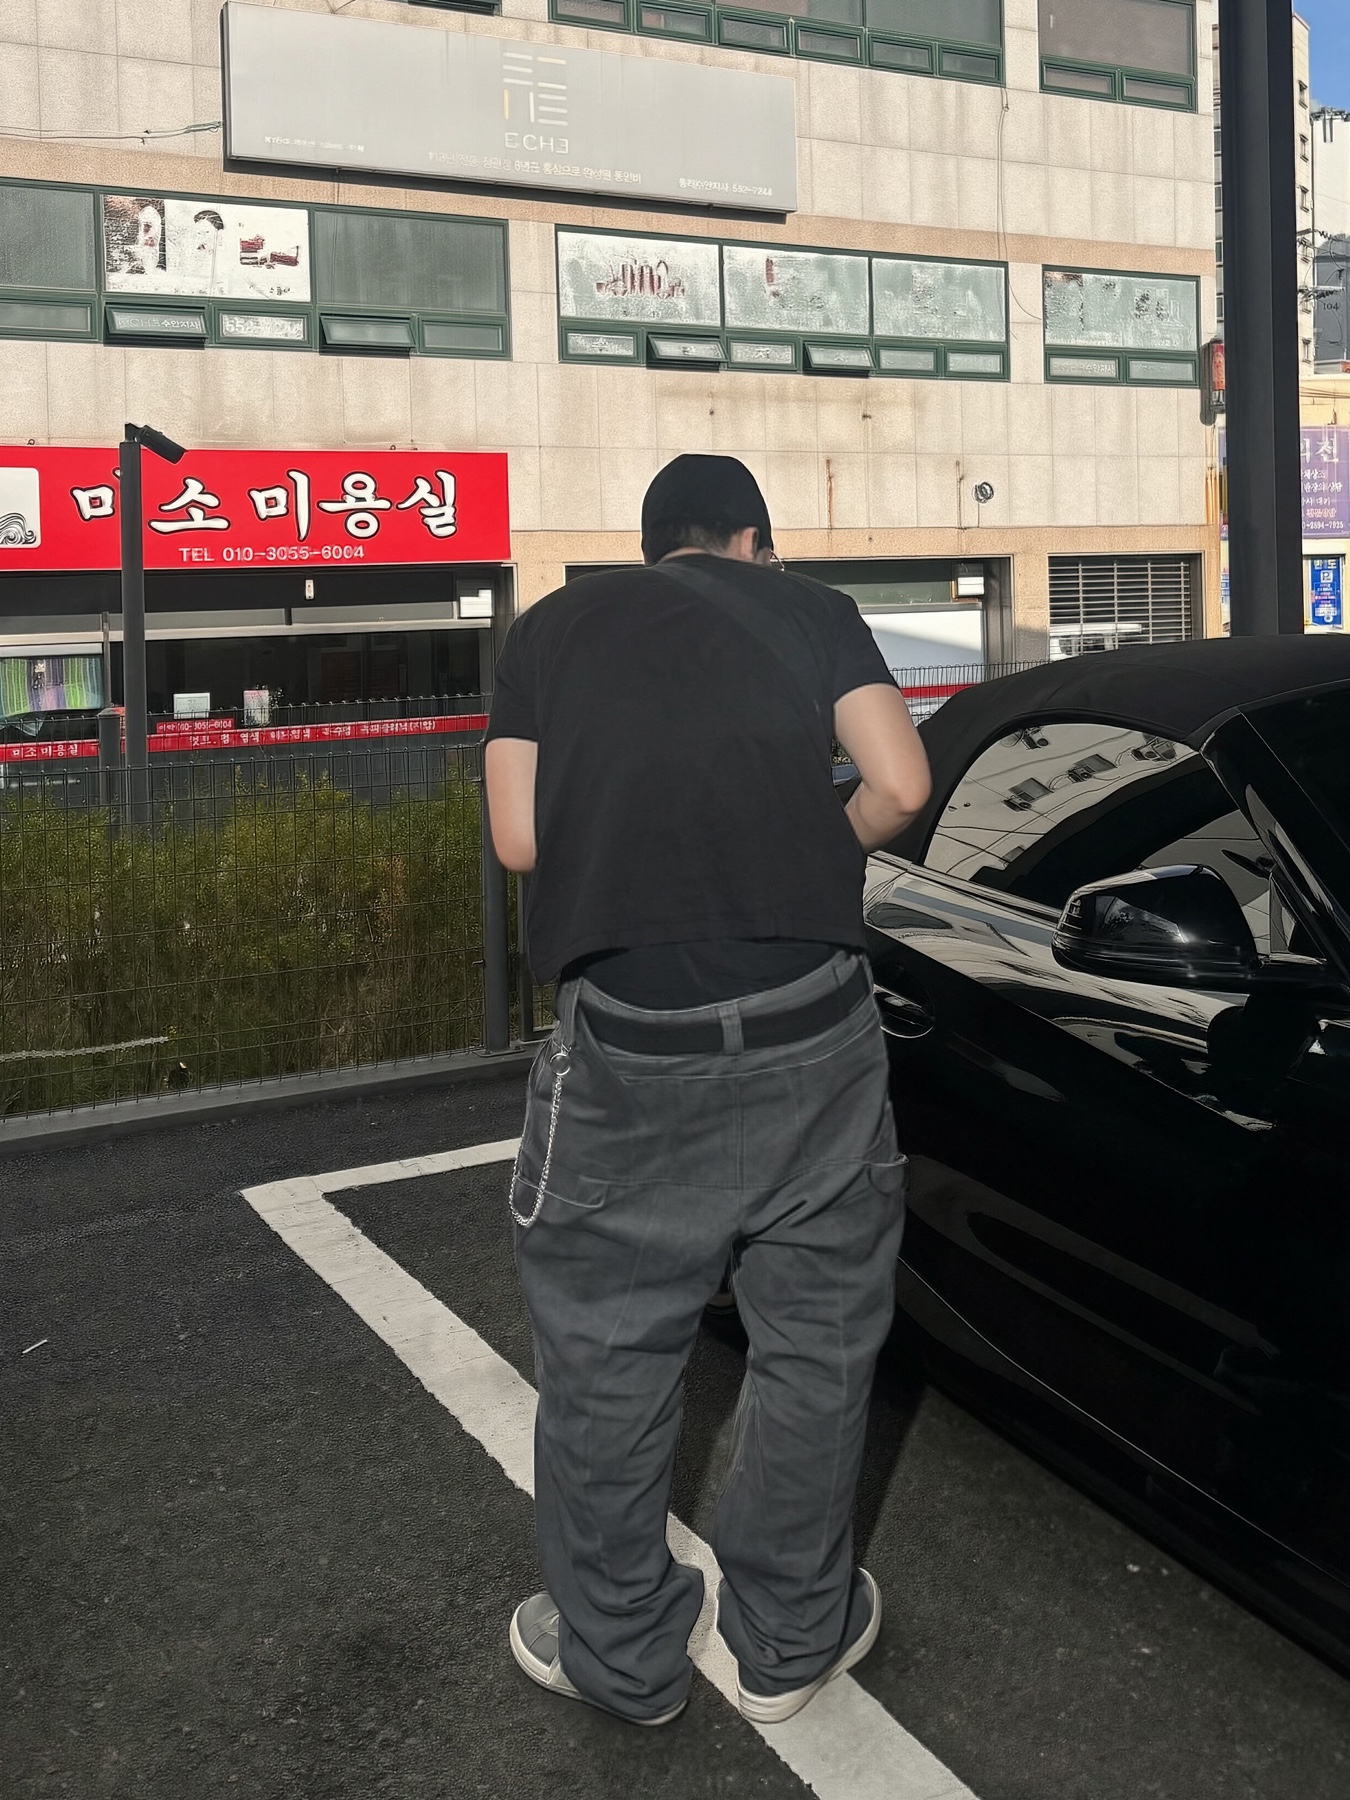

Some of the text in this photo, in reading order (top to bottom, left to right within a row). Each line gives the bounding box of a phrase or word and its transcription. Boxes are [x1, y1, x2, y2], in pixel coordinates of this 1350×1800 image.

[482, 156, 512, 171] 정관장
[514, 160, 540, 174] 6년근
[542, 163, 581, 177] 홍삼으로
[1323, 302, 1339, 311] 104
[248, 468, 459, 542] 미용실
[179, 544, 365, 562] TEL 010-3055-6004
[12, 744, 78, 758] 미소 미용실
